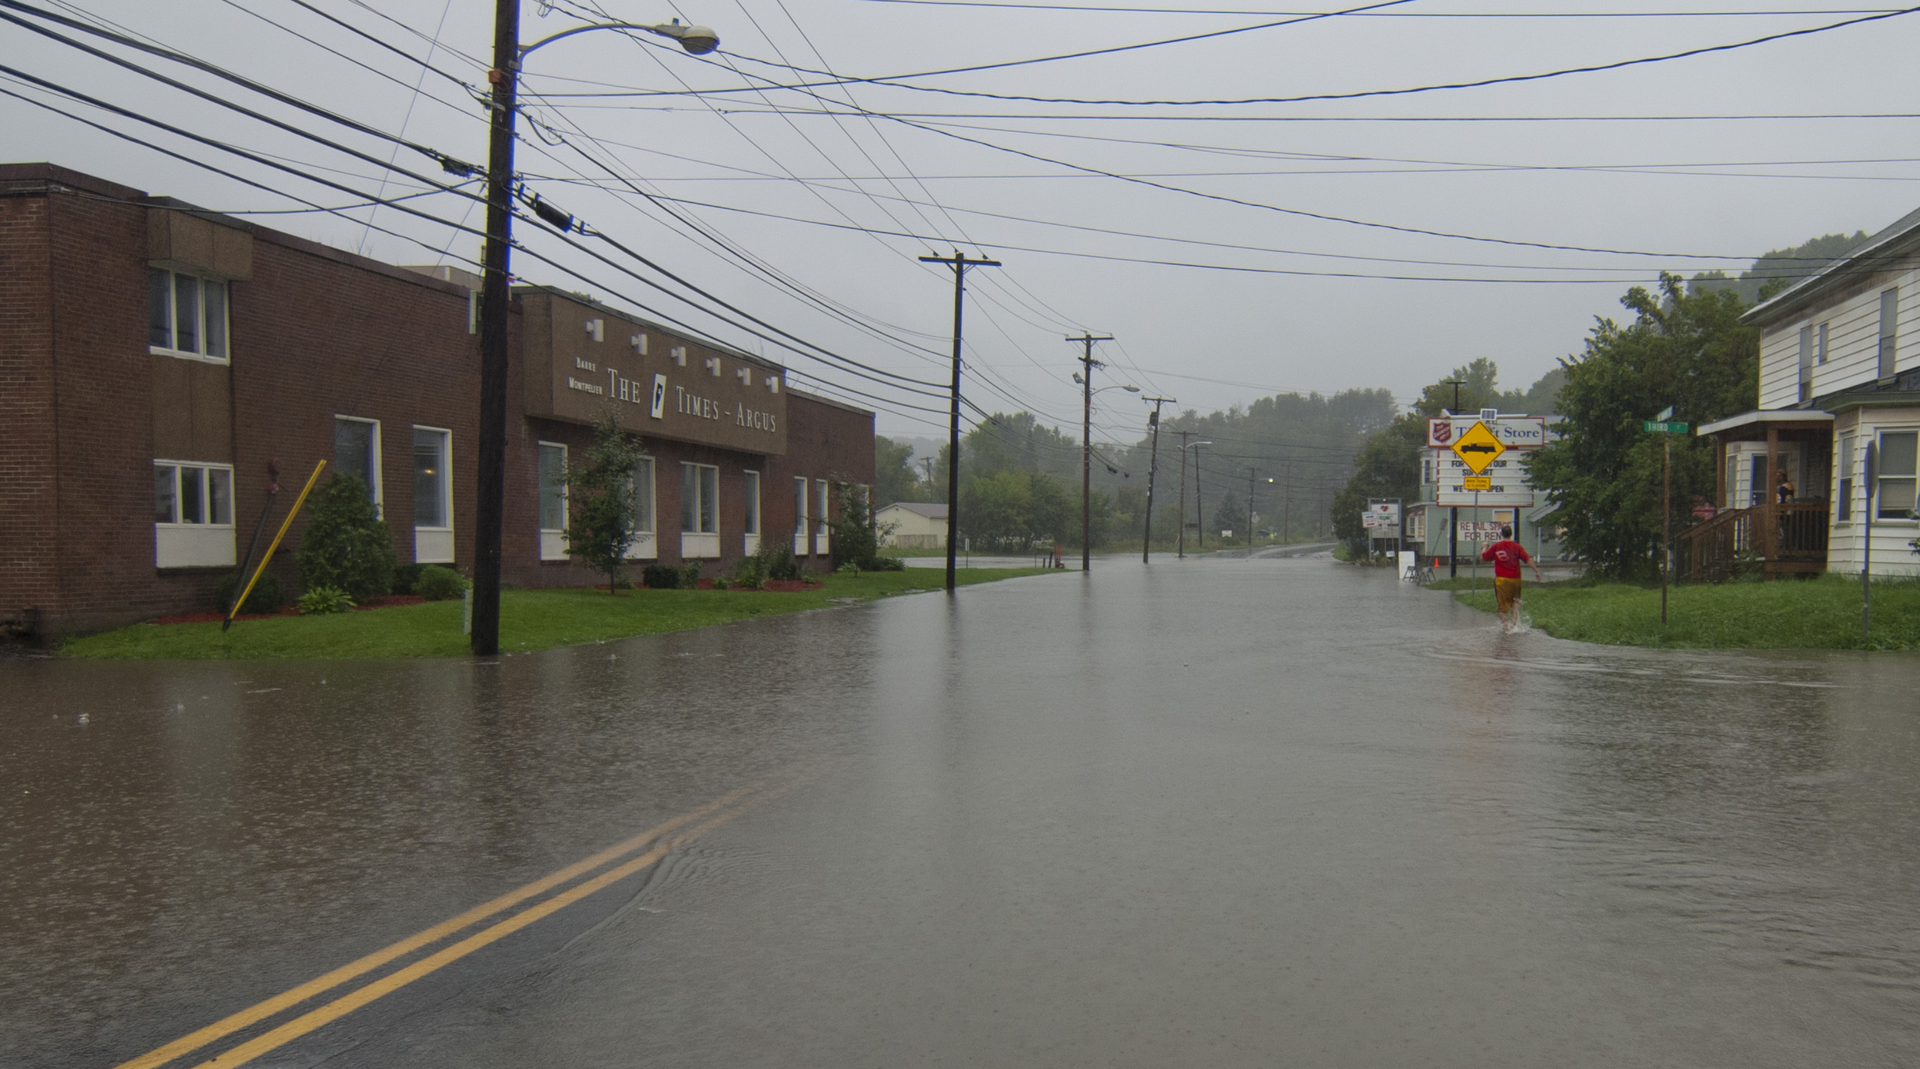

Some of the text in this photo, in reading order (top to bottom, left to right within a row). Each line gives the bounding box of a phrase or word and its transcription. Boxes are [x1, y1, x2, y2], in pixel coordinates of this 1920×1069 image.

[568, 377, 603, 395] MONTPELIER
[607, 367, 640, 404] THE
[676, 385, 719, 420] TIMES
[736, 402, 776, 432] ARGUS
[1504, 426, 1540, 438] Store
[1460, 521, 1487, 531] RETAIL
[1464, 532, 1503, 541] FOR REN
